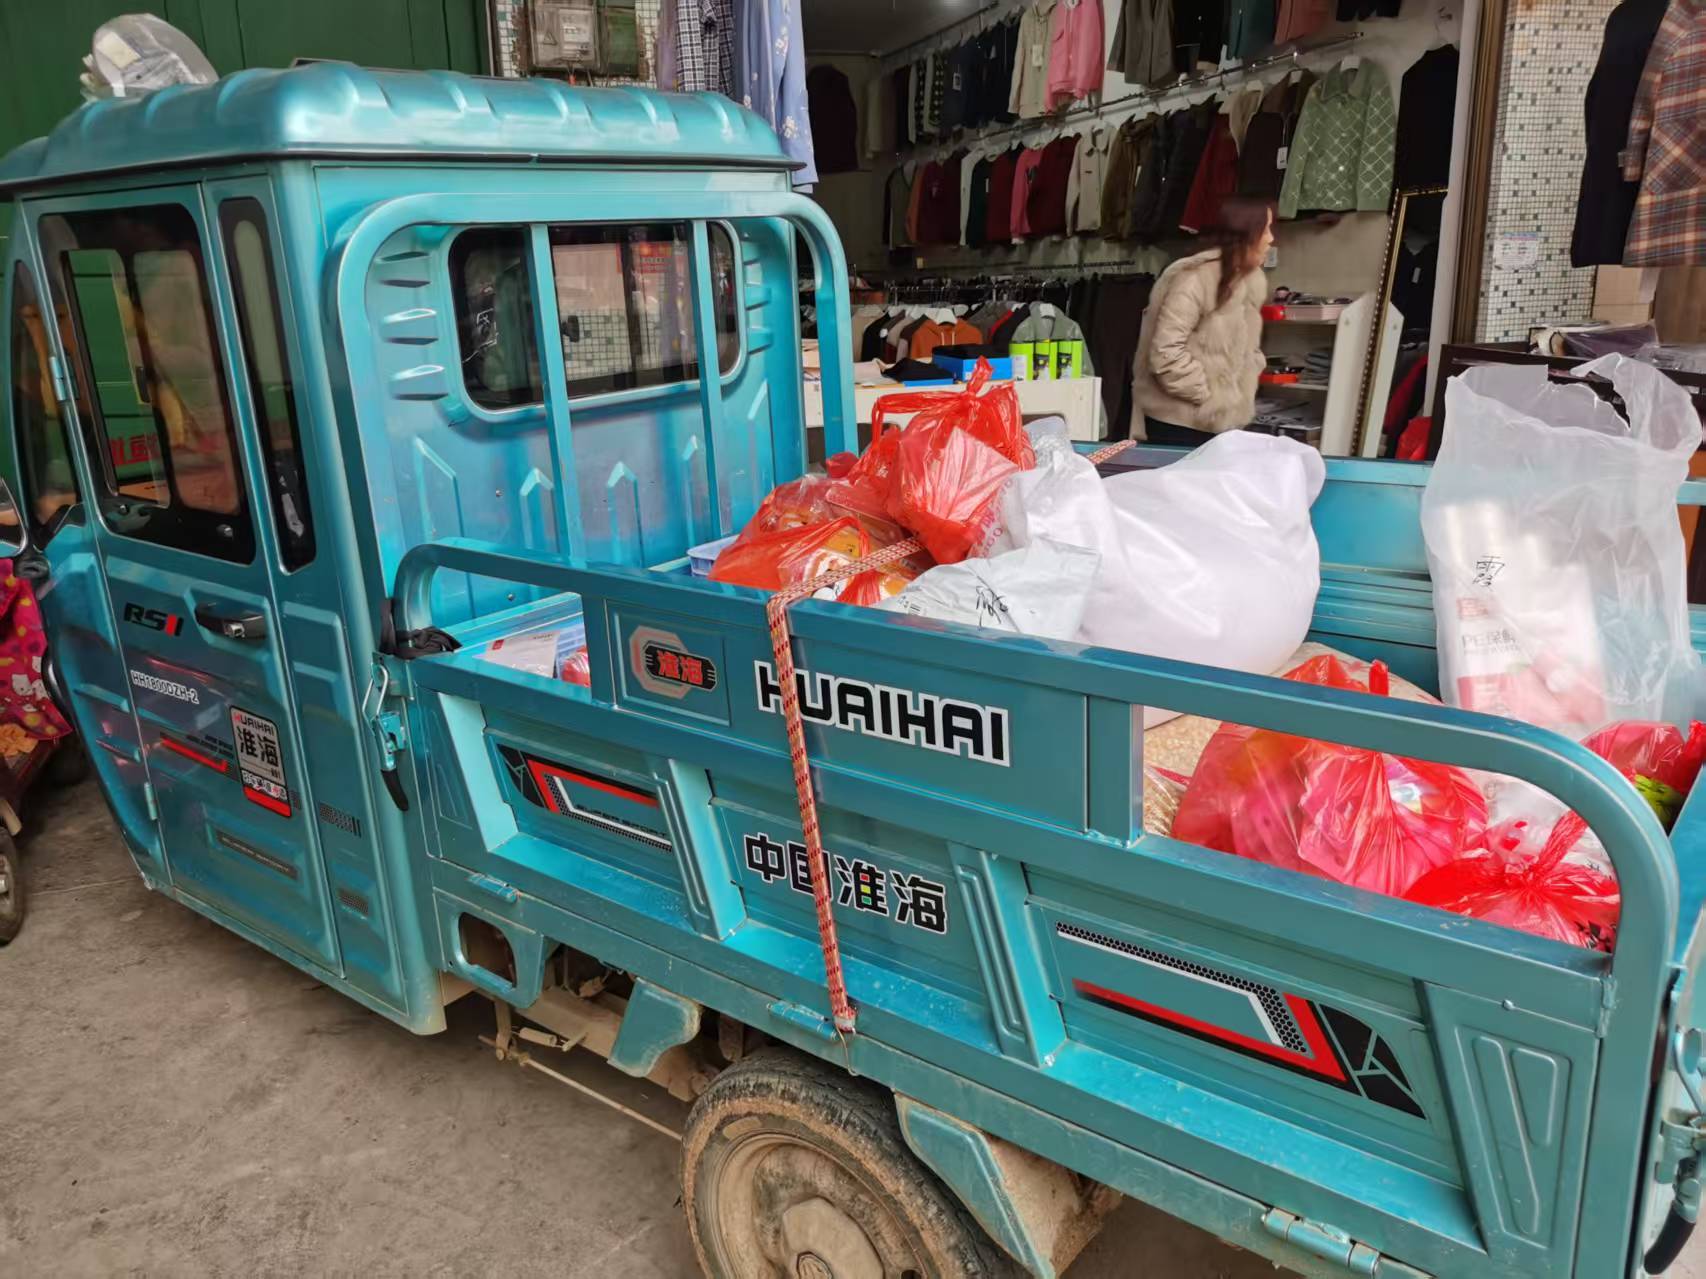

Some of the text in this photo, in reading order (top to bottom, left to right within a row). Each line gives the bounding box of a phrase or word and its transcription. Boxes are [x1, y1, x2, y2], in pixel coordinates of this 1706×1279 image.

[236, 725, 279, 767] 淮海
[754, 660, 1010, 767] HUAIHAI
[744, 832, 947, 934] 中国淮海
